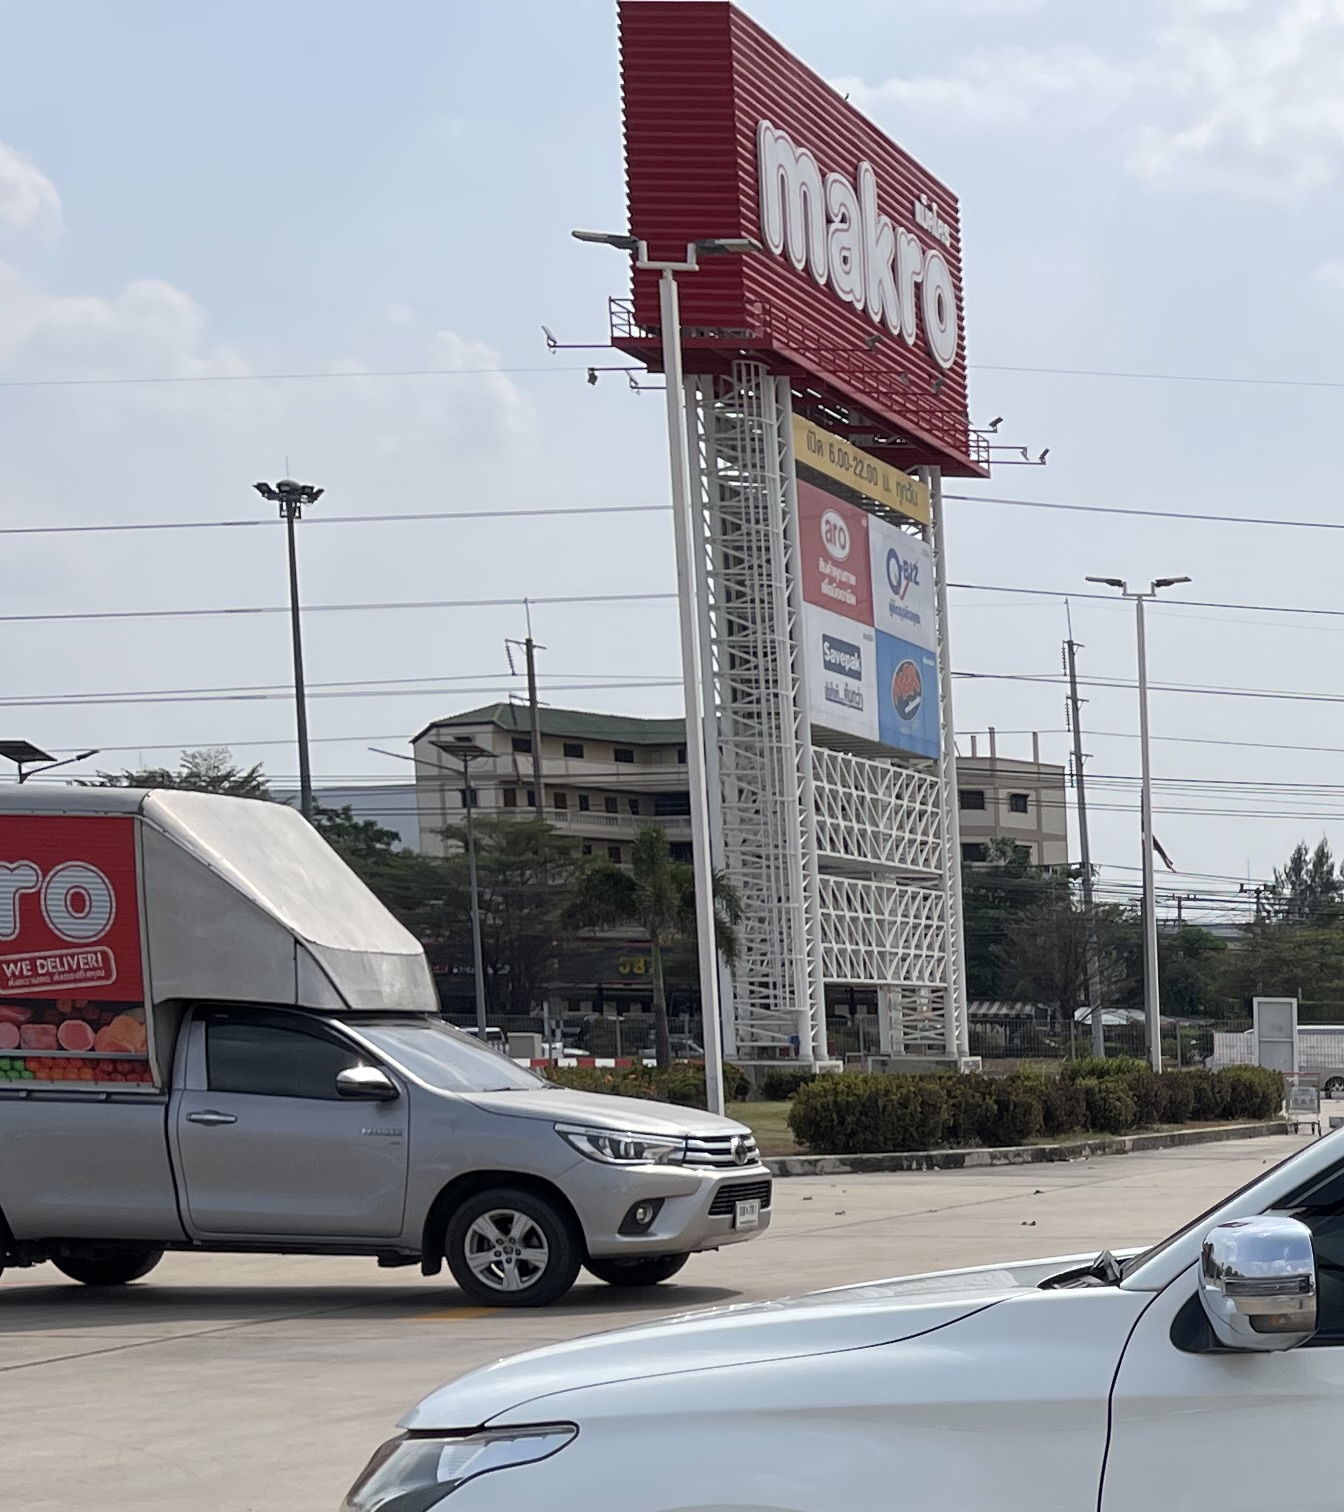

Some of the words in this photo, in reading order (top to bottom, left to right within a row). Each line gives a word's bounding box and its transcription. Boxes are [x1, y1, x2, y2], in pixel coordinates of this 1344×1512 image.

[757, 119, 958, 369] makro
[806, 429, 824, 459] เปิด
[829, 442, 878, 487] 6.00-22.00
[824, 517, 847, 551] aro
[822, 640, 862, 673] Savepak
[2, 961, 32, 978] WE
[36, 952, 104, 974] DELIVER!
